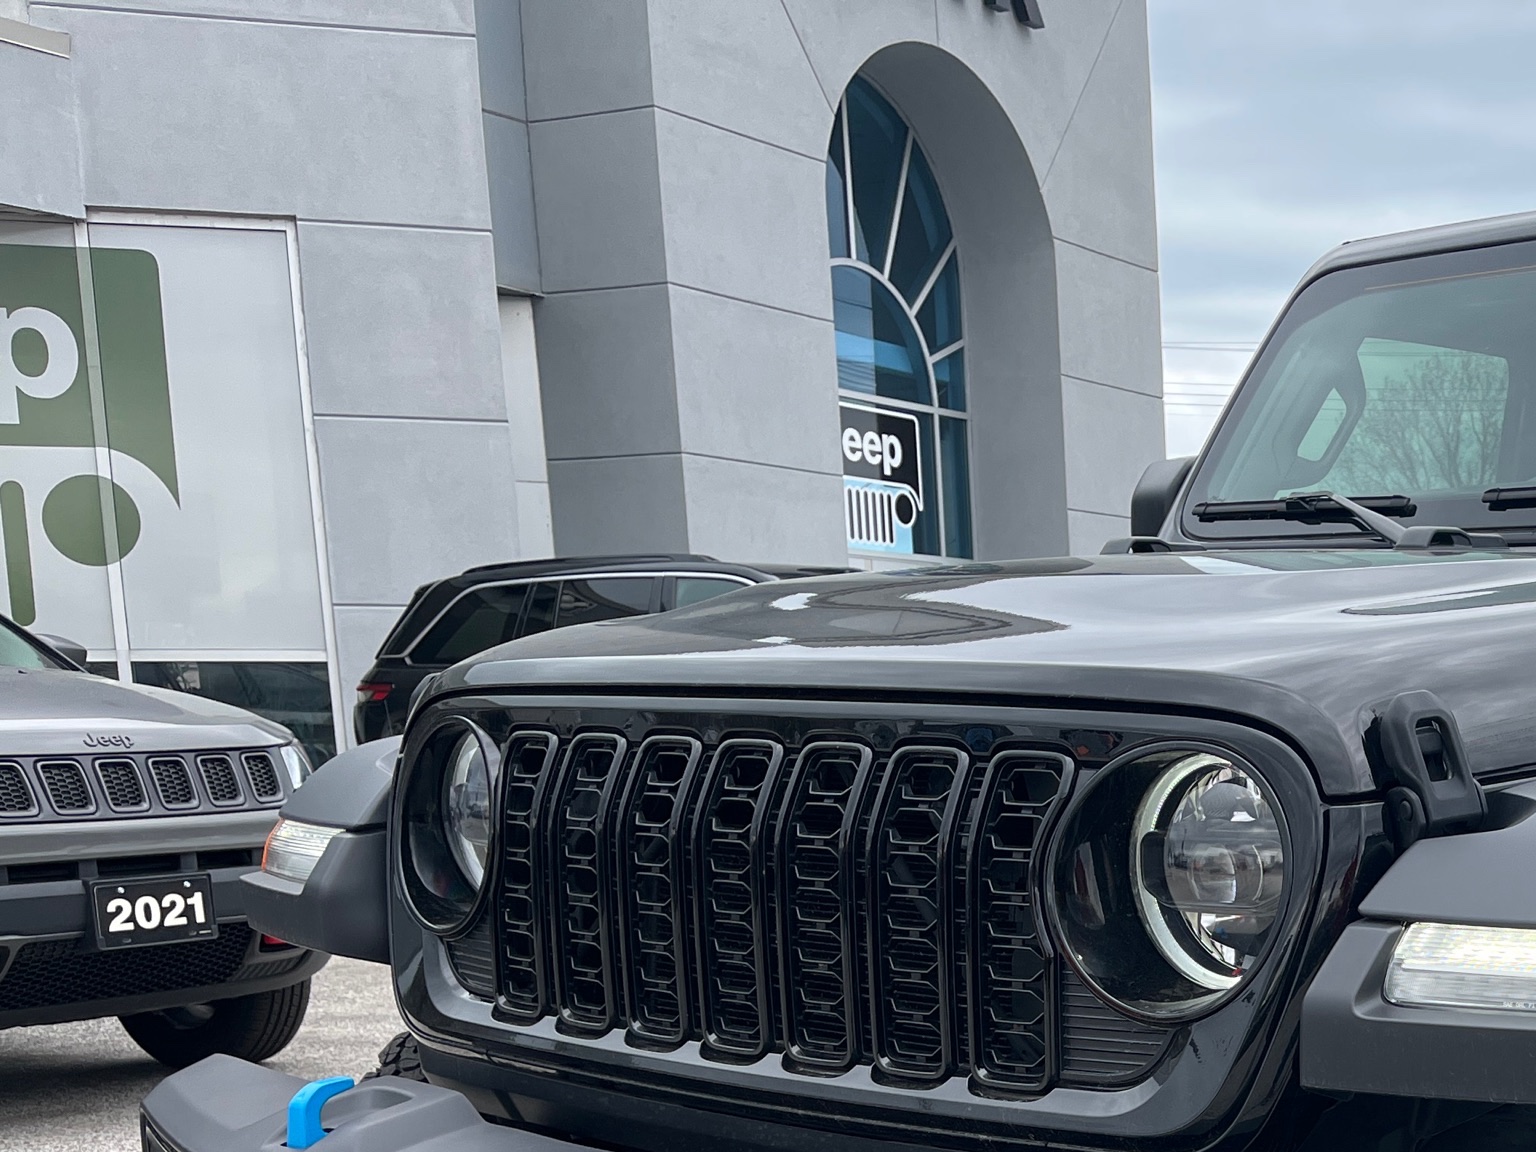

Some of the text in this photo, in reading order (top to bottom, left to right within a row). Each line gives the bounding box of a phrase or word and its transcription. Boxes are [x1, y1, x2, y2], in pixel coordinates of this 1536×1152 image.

[842, 427, 903, 476] eep
[82, 732, 135, 749] Jeep
[106, 891, 206, 933] 2021
